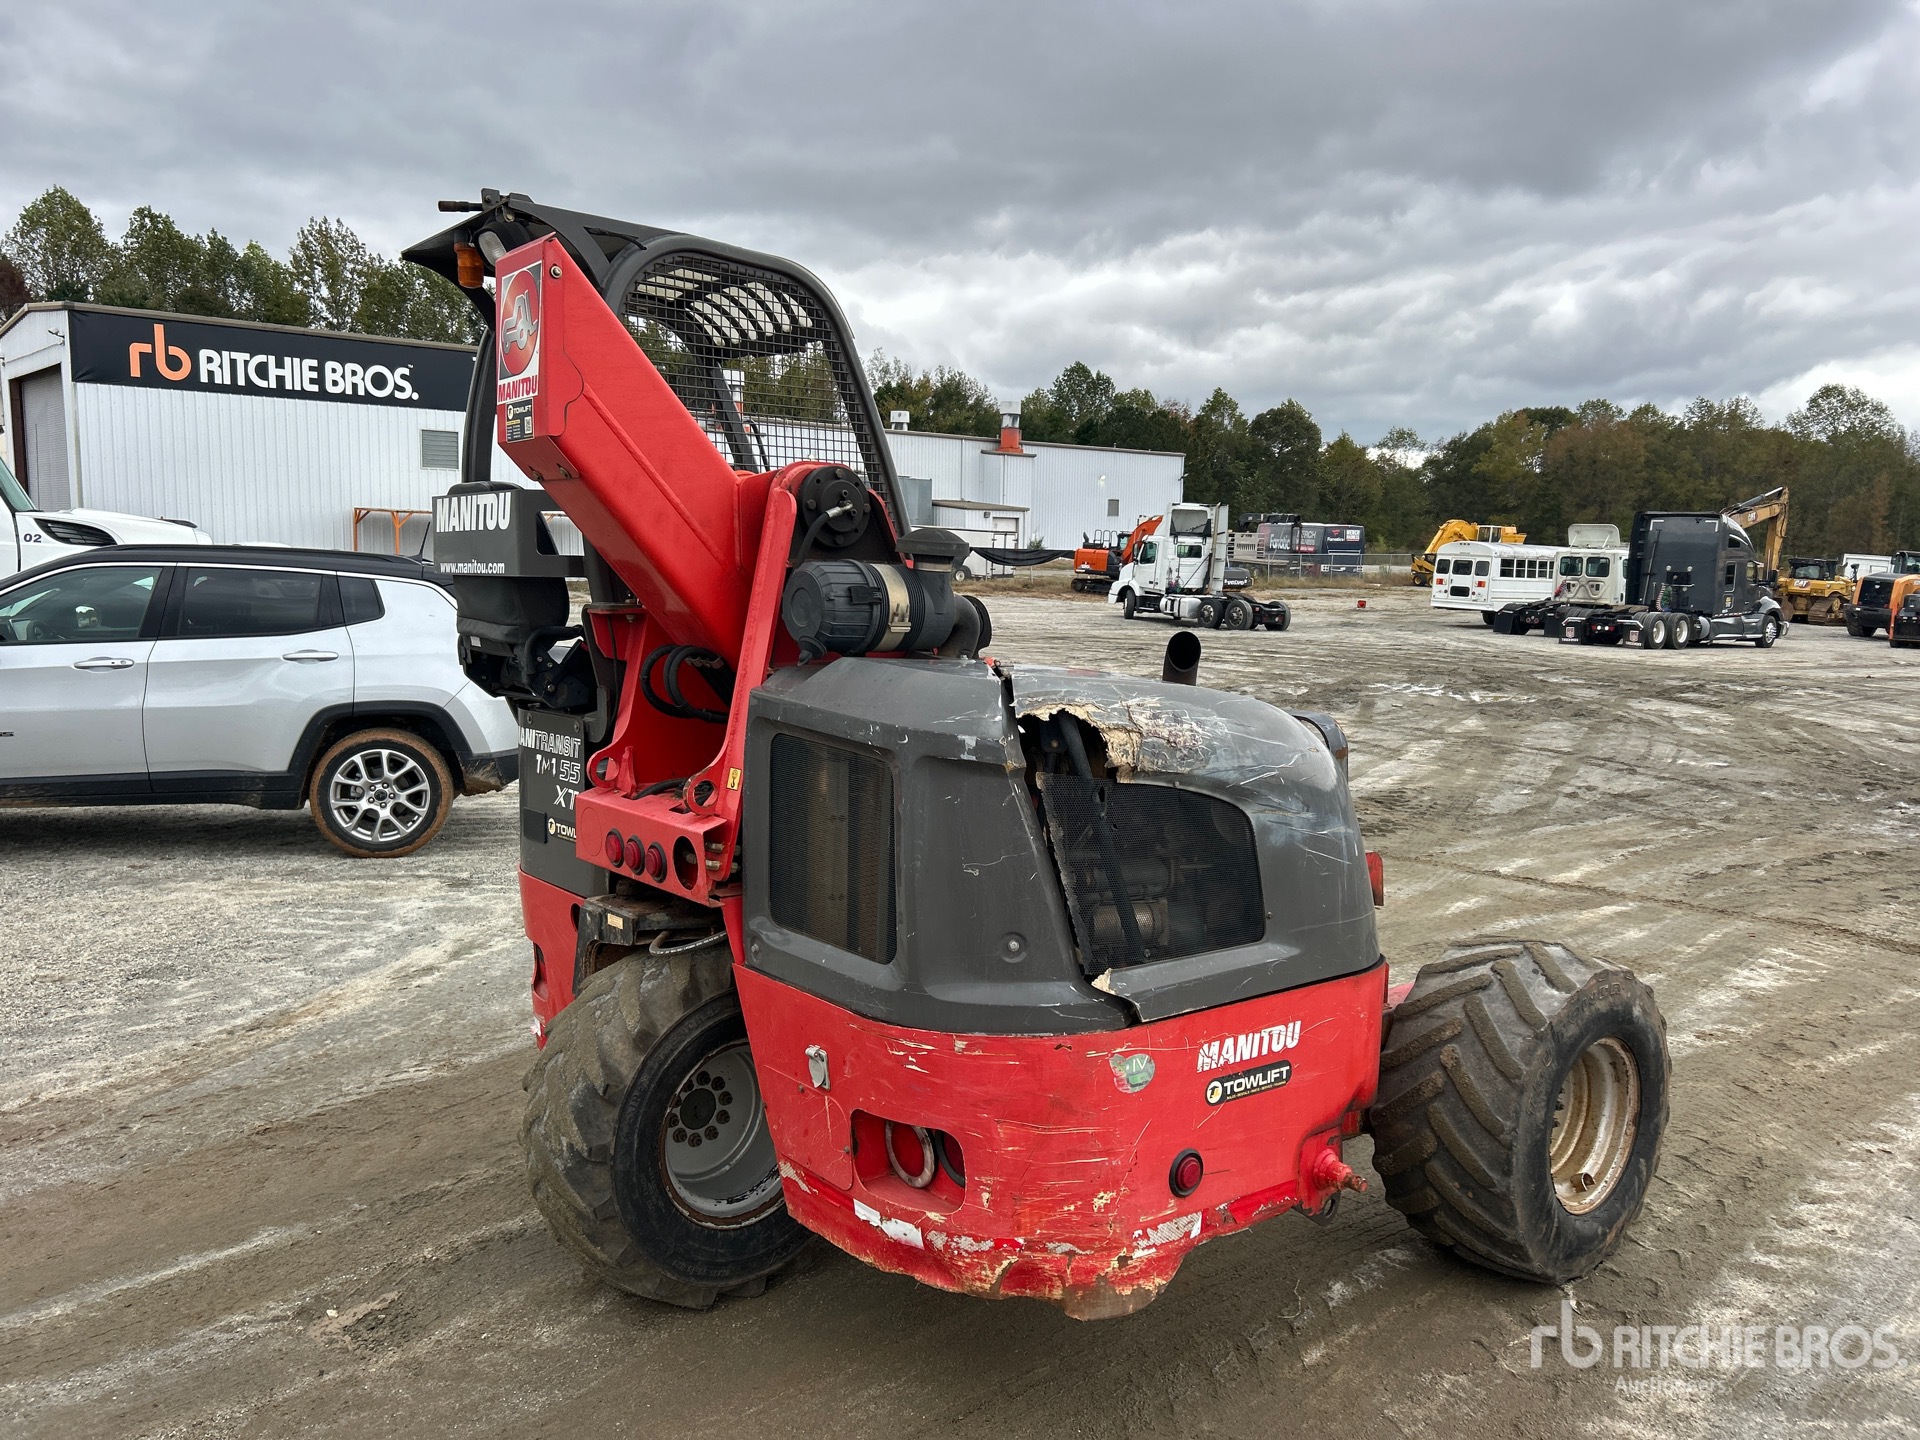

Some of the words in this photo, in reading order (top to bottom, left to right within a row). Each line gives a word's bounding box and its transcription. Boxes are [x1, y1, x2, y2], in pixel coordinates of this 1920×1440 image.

[129, 323, 192, 381] rb
[199, 348, 319, 393] RITCHIE
[325, 360, 420, 401] BROS.
[498, 374, 538, 403] MANITOU
[436, 491, 512, 533] MANITOU
[1747, 511, 1757, 522] CAT
[23, 533, 42, 543] 02
[439, 558, 505, 574] www.manitou.com
[1793, 580, 1808, 588] CAT
[518, 725, 581, 759] ANITRANSIT
[559, 759, 581, 784] 55
[555, 823, 577, 839] TOWL
[1196, 1020, 1302, 1074] MANITOU
[1223, 1065, 1291, 1096] TOWLIFT
